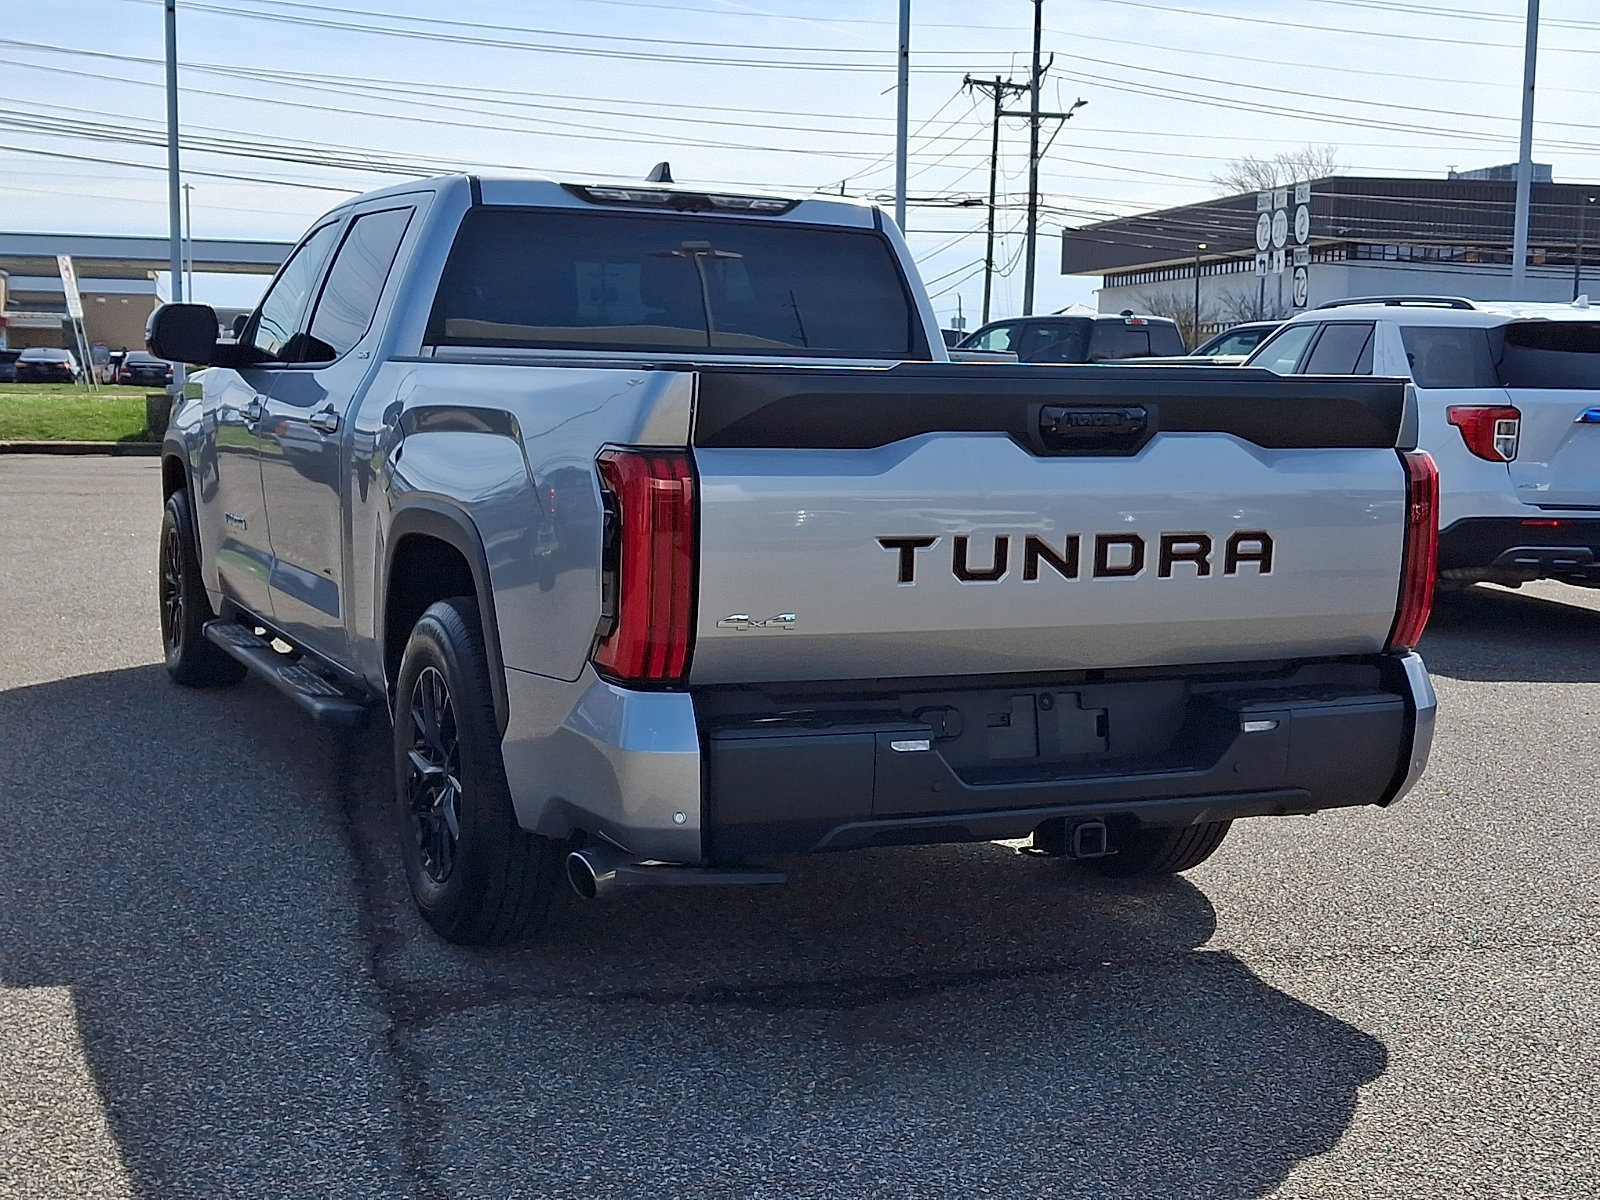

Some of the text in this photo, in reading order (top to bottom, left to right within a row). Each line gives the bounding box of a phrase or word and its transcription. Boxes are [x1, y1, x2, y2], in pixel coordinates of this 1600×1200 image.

[1258, 221, 1269, 243] 72
[1299, 214, 1306, 236] 2
[1295, 276, 1306, 298] 72
[875, 529, 1277, 587] TUNDRA
